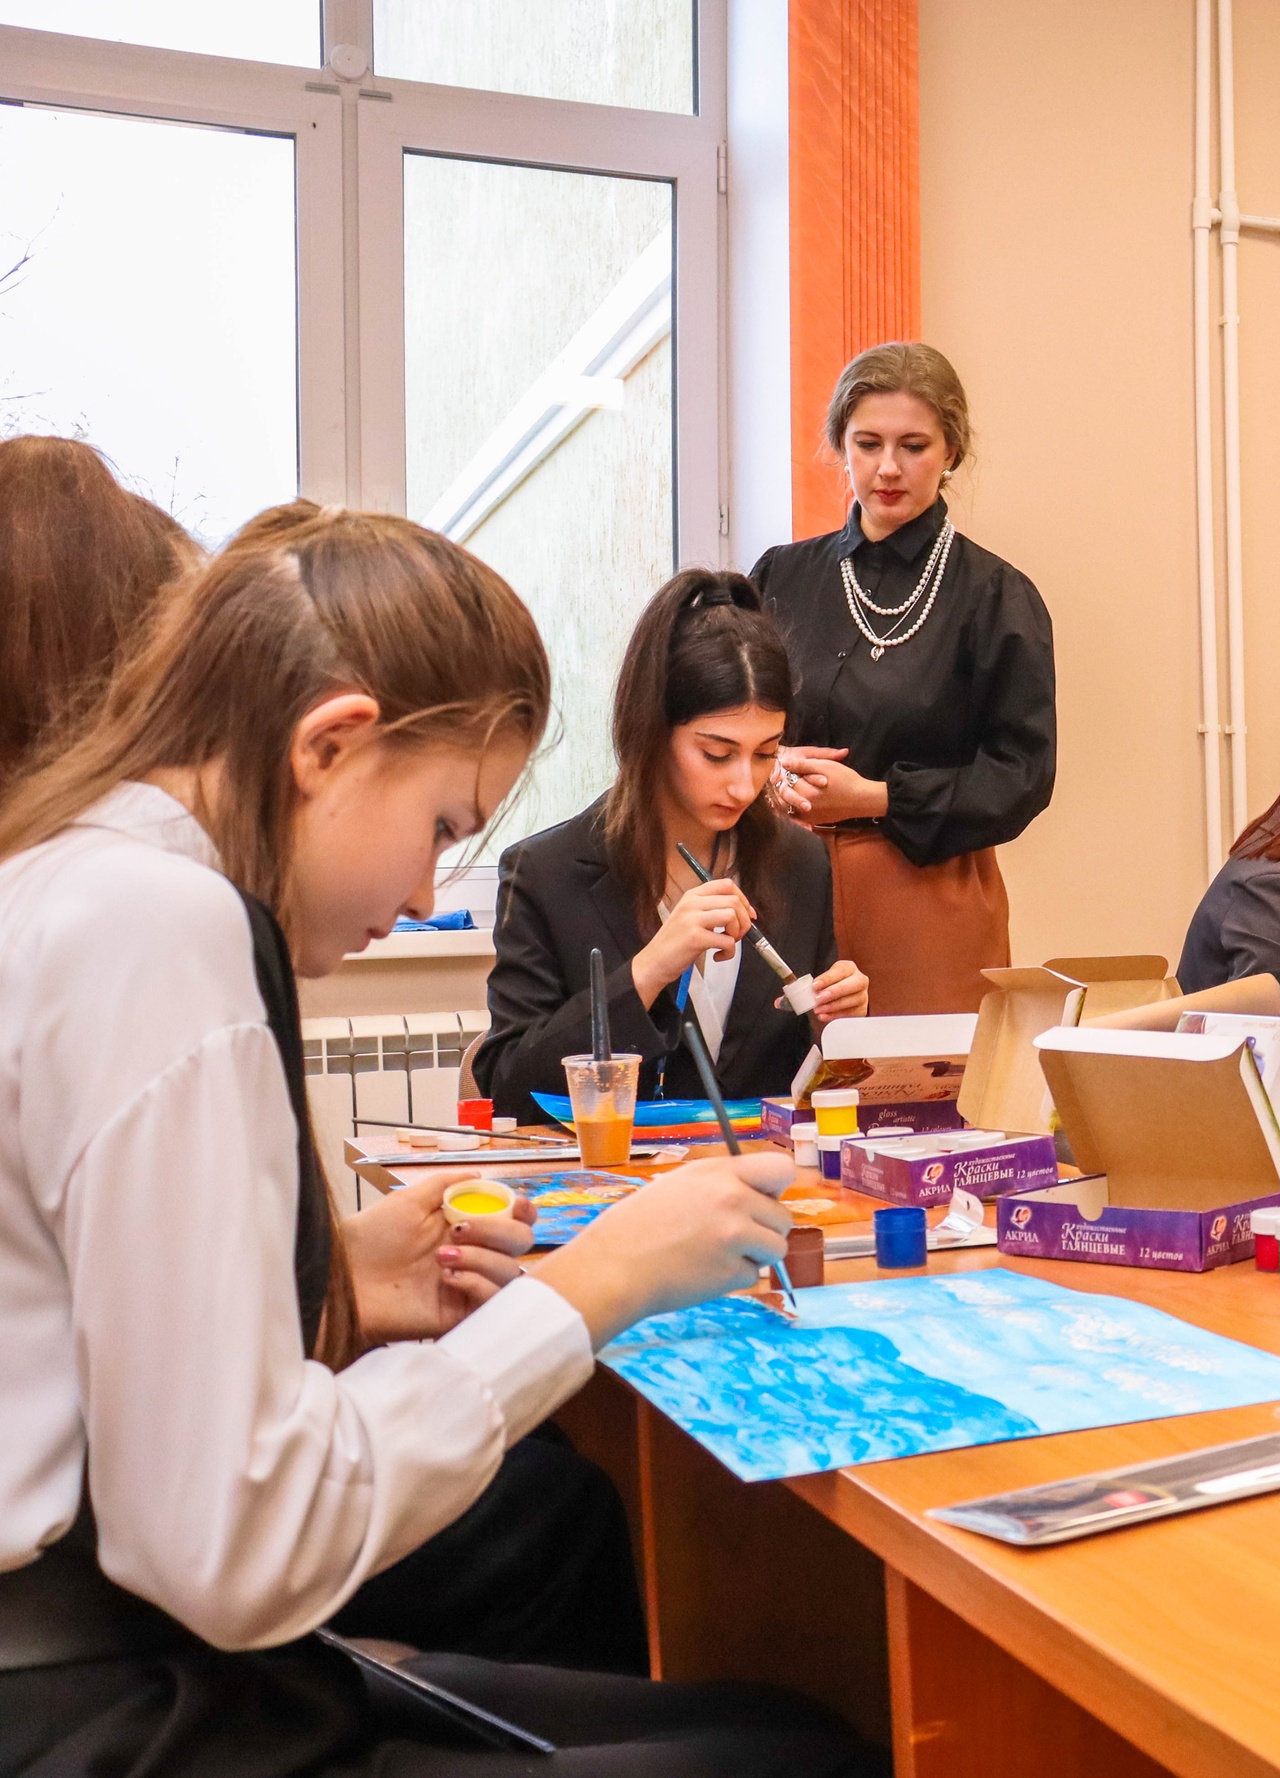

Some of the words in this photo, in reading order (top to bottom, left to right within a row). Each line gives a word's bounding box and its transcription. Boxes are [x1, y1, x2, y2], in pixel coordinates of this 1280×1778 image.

[878, 1108, 898, 1121] gloss
[953, 1161, 999, 1178] Краски
[1016, 1170, 1026, 1179] 12
[1026, 1167, 1054, 1178] цветов
[954, 1168, 1014, 1188] ГЛЯНЦЕВЫЕ
[919, 1184, 951, 1198] АКРИЛ
[1004, 1231, 1039, 1243] АКРИЛ
[1061, 1222, 1109, 1243] Краски
[1061, 1240, 1126, 1256] ГЛЯНЦЕВЫЕ
[1139, 1247, 1150, 1258] 12
[1151, 1249, 1184, 1261] цветов
